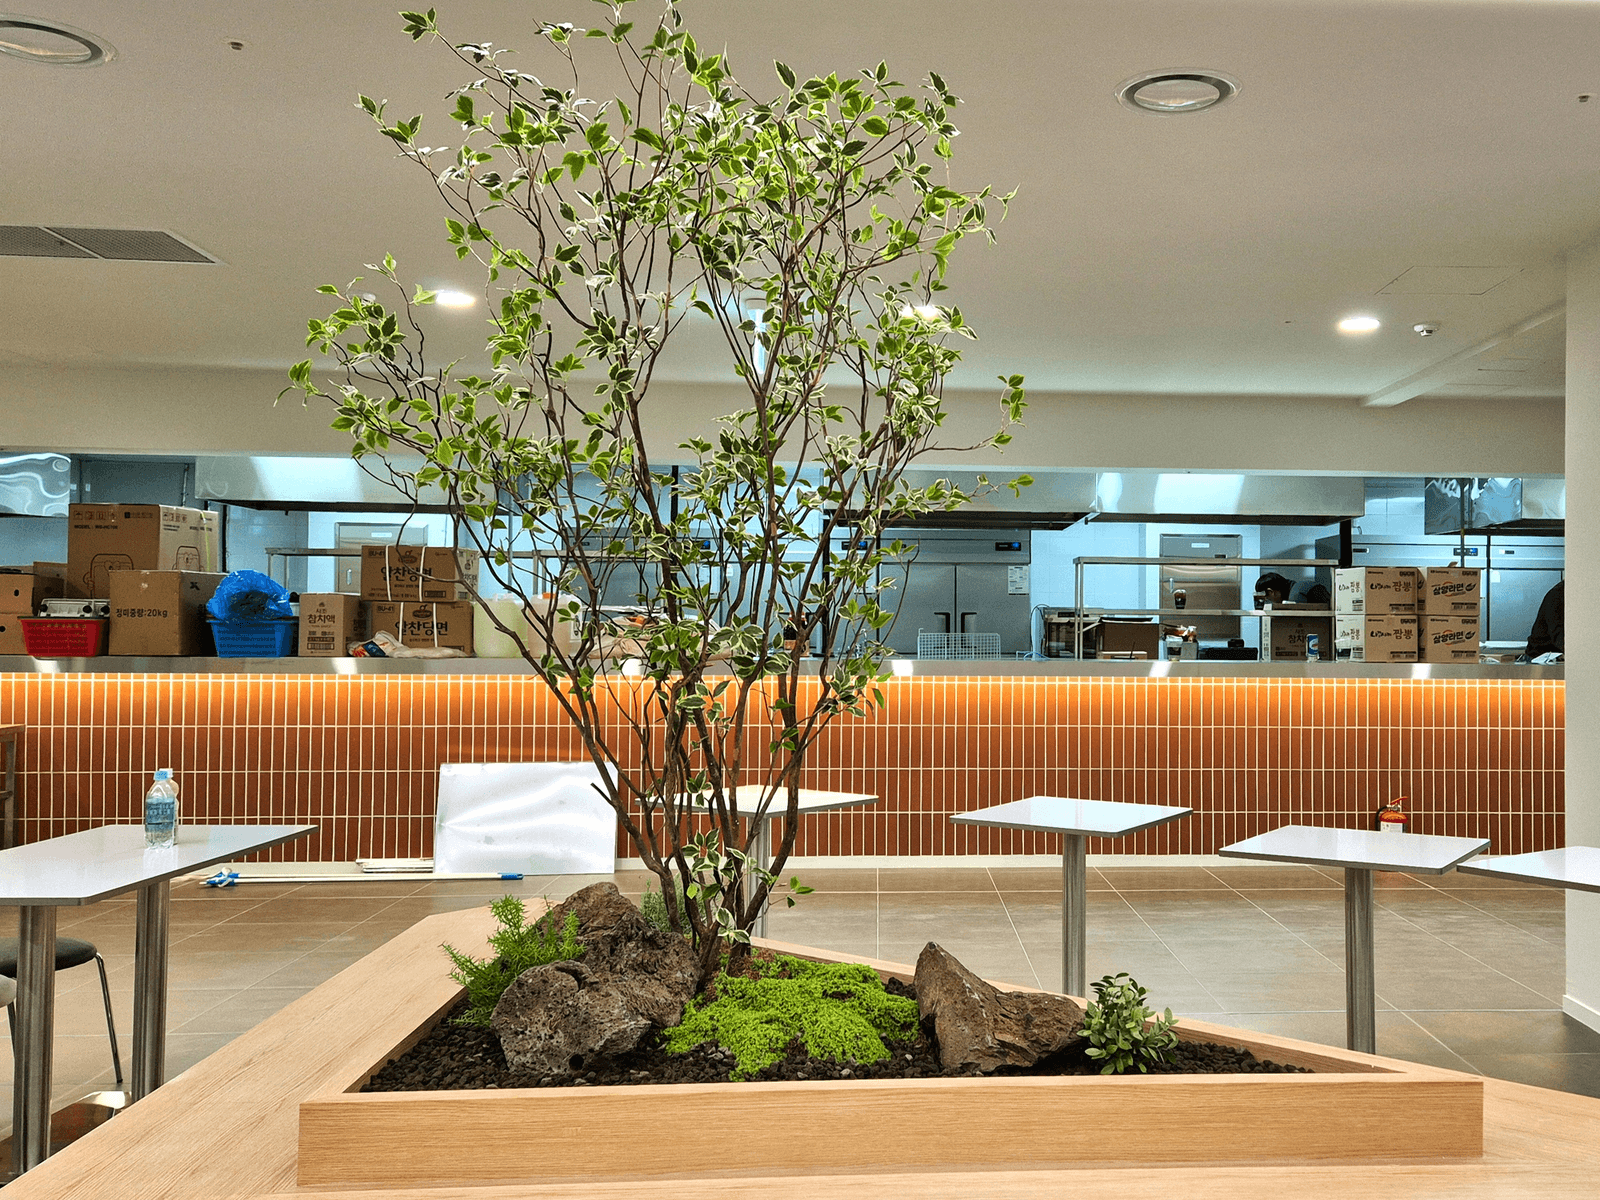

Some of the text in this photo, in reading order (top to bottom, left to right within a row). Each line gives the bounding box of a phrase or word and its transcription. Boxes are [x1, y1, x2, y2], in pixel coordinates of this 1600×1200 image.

[1392, 581, 1412, 592] 짬뽕
[1433, 583, 1464, 595] 삼양라면
[307, 614, 335, 624] 참치액
[1288, 634, 1307, 644] 참치
[1393, 628, 1413, 640] 짬뽕
[1433, 631, 1464, 644] 삼양라면
